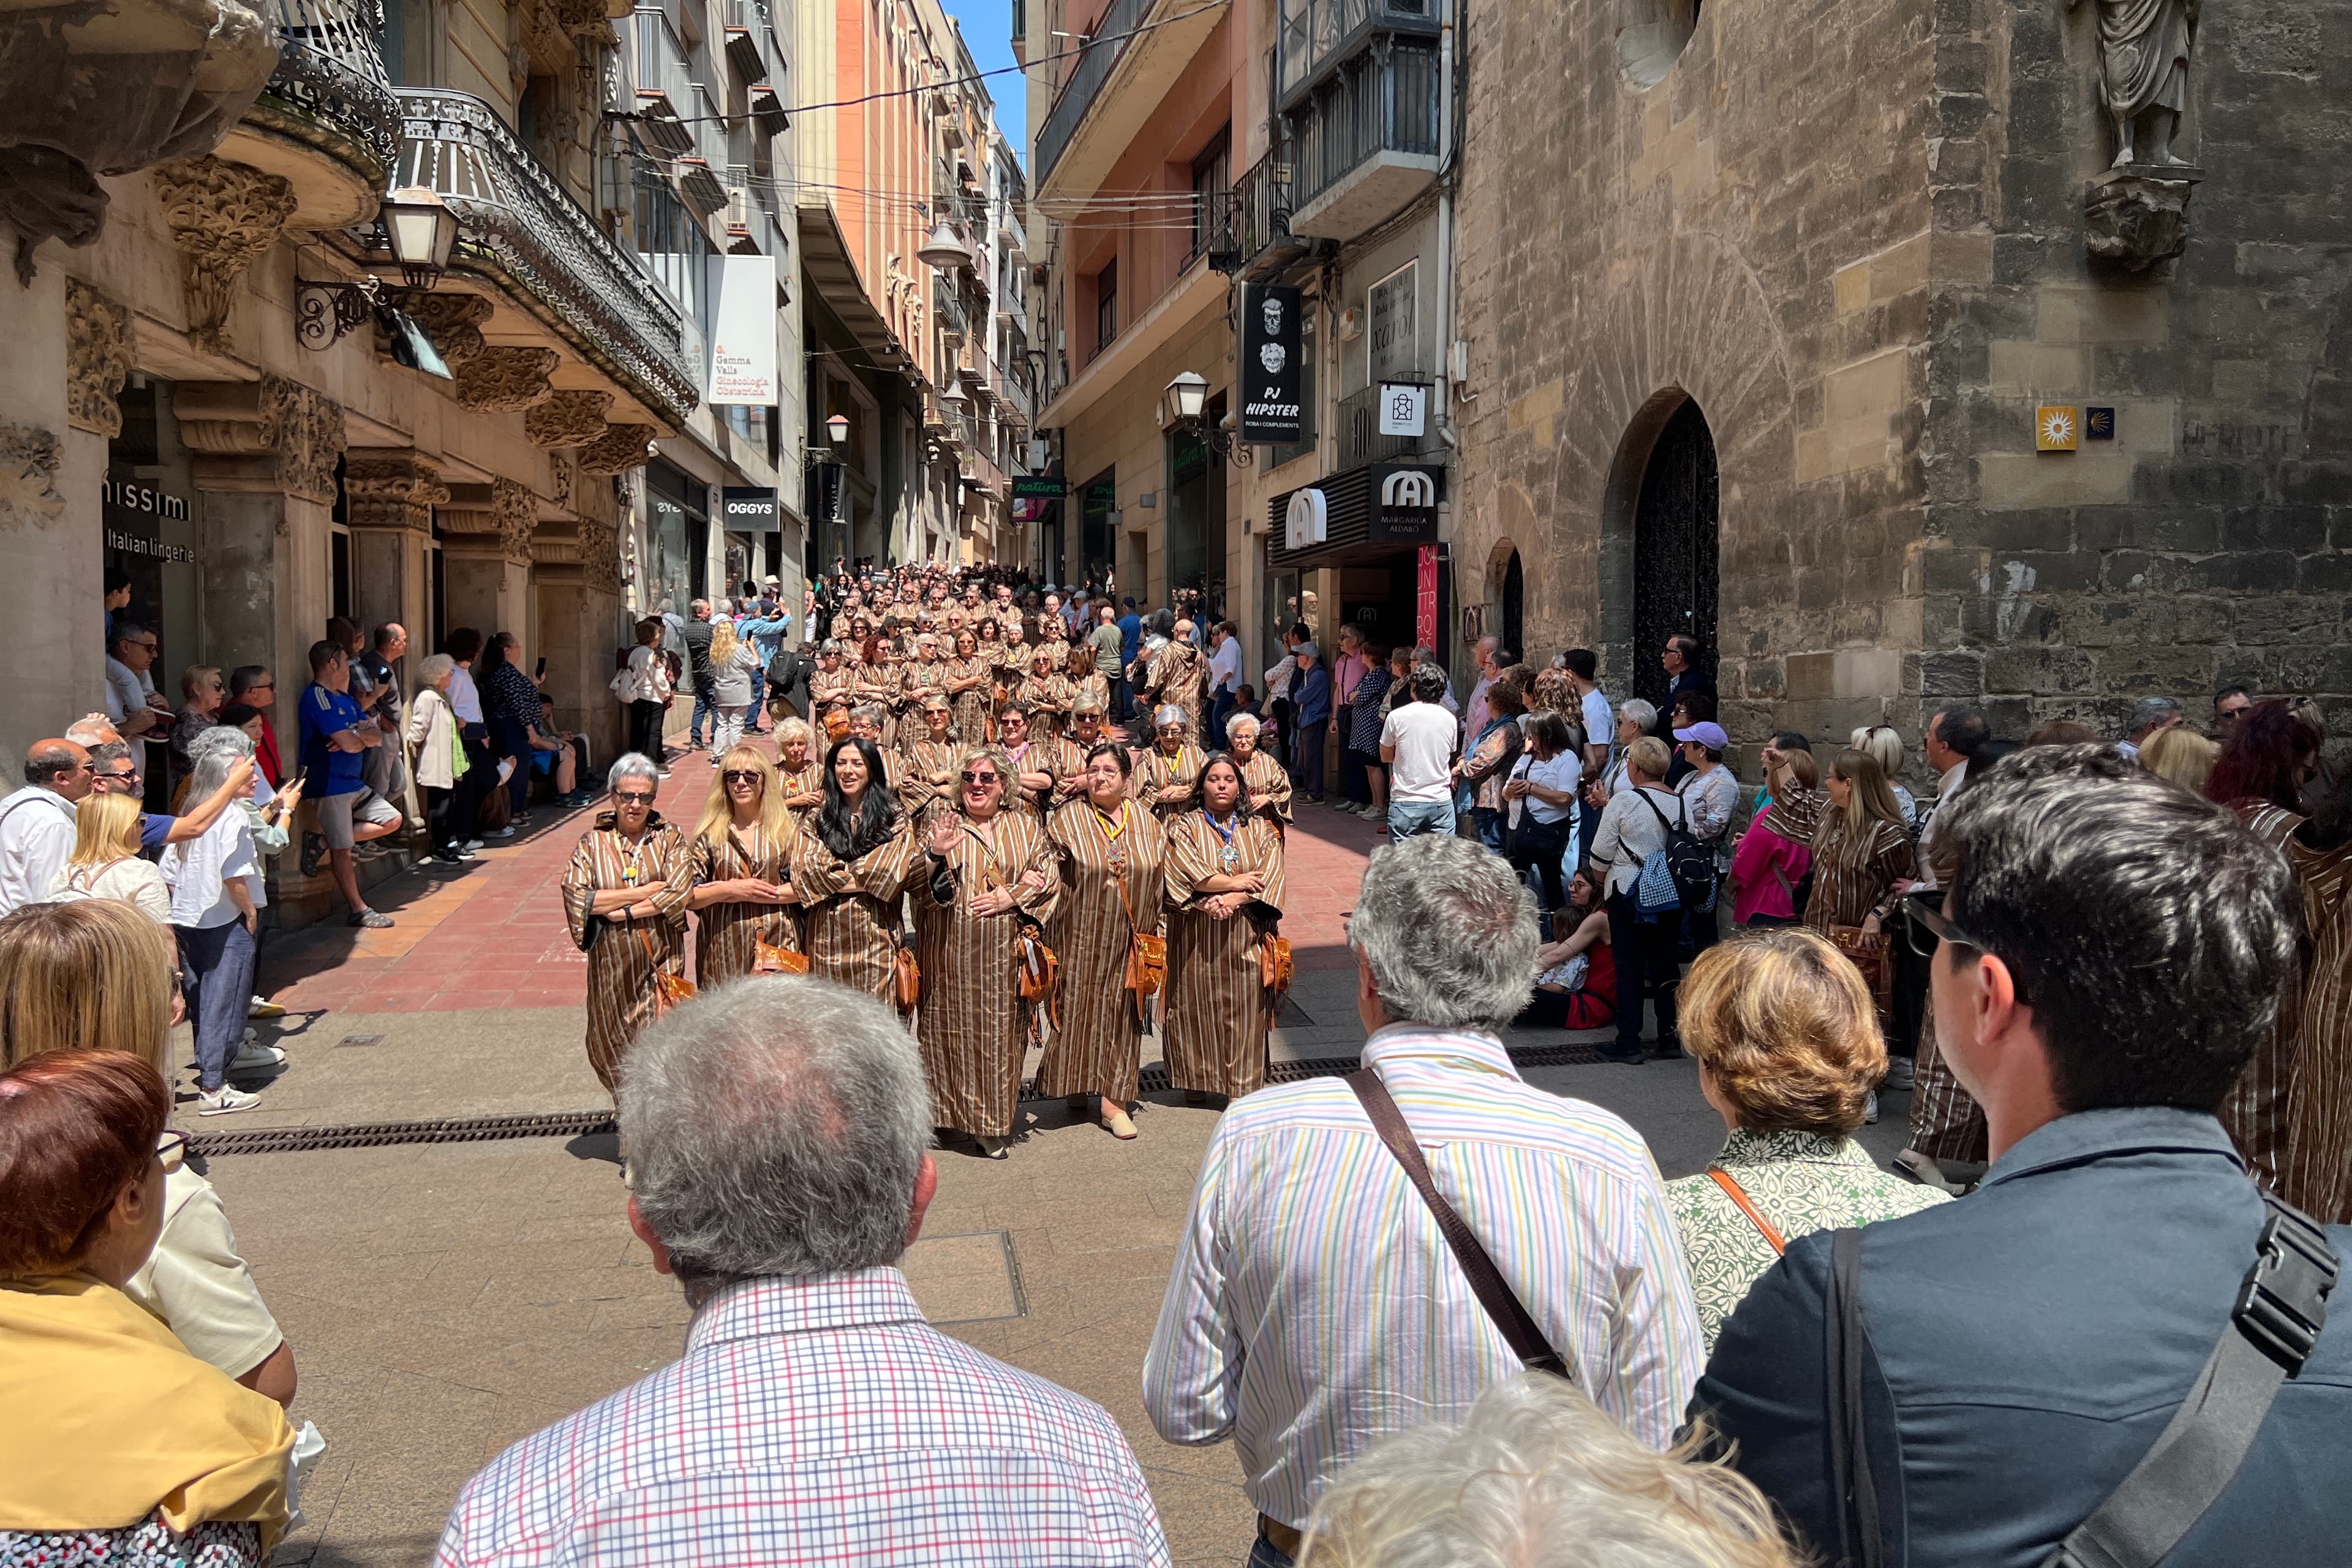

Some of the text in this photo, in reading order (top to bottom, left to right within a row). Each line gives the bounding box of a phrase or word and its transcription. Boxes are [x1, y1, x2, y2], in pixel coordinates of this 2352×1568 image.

[716, 356, 751, 364] Gemma
[1264, 386, 1281, 399] PJ
[1246, 402, 1299, 417] HIPSTER
[1016, 481, 1063, 493] natura
[727, 503, 772, 514] OGGYS
[108, 528, 194, 564] Italian lingerie
